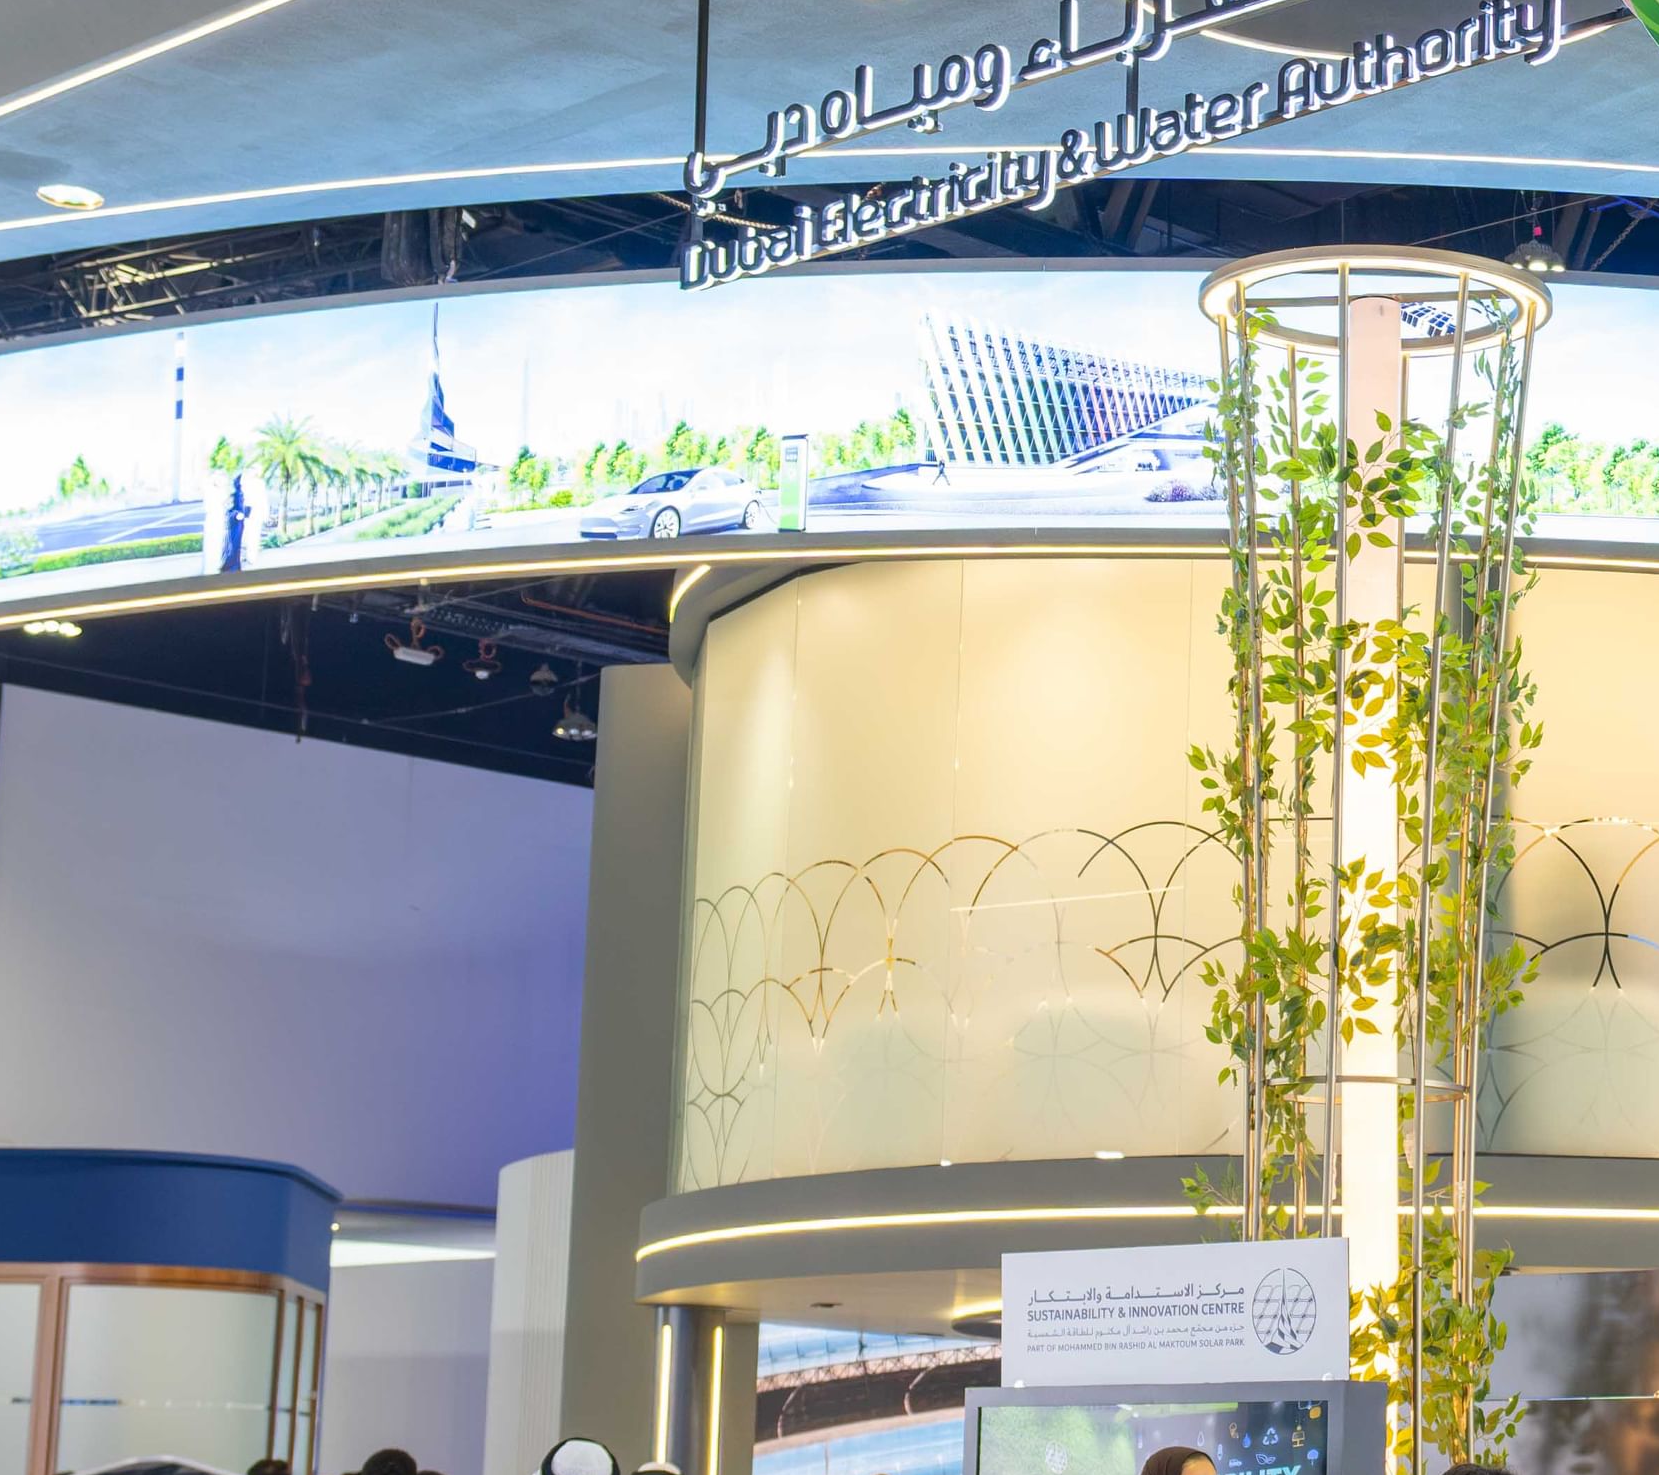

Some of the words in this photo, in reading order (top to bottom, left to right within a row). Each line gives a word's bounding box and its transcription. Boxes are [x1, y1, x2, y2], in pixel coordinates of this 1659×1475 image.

[821, 44, 1011, 137] ومياه
[684, 103, 816, 216] دبي
[680, 206, 813, 291] Dubai
[819, 148, 1057, 251] Electricity
[1060, 128, 1094, 182] &
[1095, 81, 1268, 169] Water
[1027, 1287, 1102, 1306] والابتكار
[1105, 1283, 1194, 1300] الاستدامة
[1197, 1283, 1244, 1299] مركز
[1027, 1307, 1114, 1322] SUSTAINABILITY
[1117, 1306, 1126, 1318] &
[1128, 1304, 1198, 1318] INNOVATION
[1201, 1301, 1244, 1316] CENTRE
[1095, 1326, 1120, 1338] مكتوم
[1133, 1325, 1152, 1335] راشد
[1154, 1325, 1164, 1336] بن
[1166, 1325, 1188, 1334] محمد
[1027, 1344, 1044, 1353] PART
[1047, 1344, 1056, 1352] OF
[1058, 1342, 1102, 1352] MOHAMMED
[1104, 1342, 1117, 1351] BIN
[1119, 1341, 1145, 1350] RASHID
[1148, 1341, 1157, 1349] AL
[1159, 1339, 1197, 1349] MAKTOUM
[1199, 1339, 1222, 1347] SOLAR
[1225, 1338, 1244, 1347] PARK
